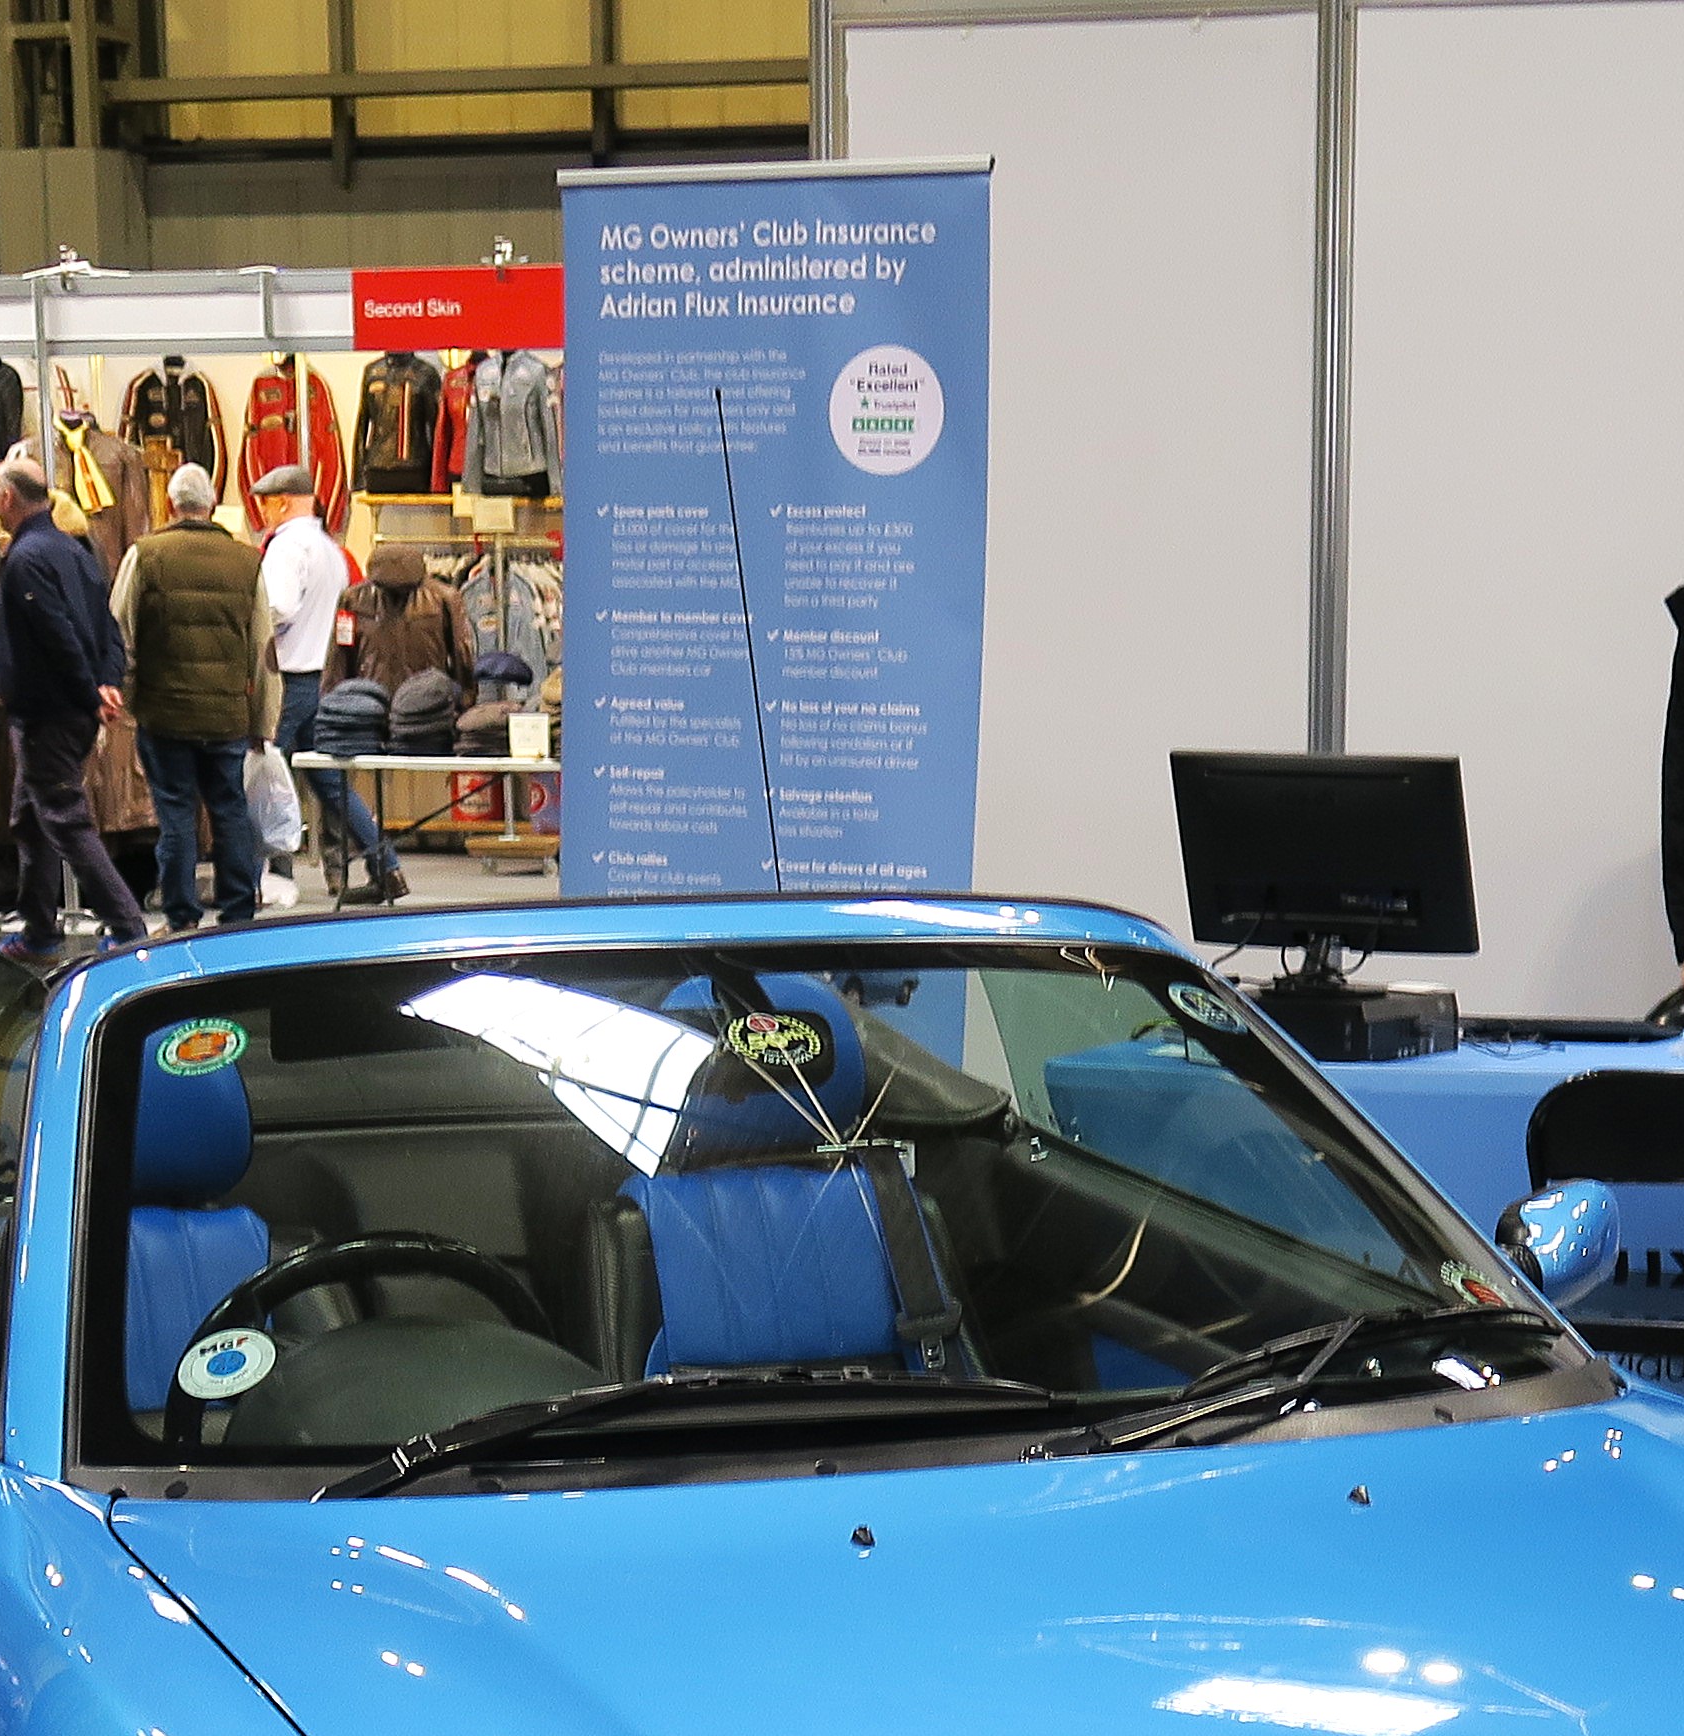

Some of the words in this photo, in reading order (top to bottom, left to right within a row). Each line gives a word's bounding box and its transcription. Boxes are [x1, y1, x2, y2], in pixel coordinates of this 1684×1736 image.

[601, 224, 642, 251] MG
[651, 222, 744, 249] Owners'
[753, 220, 807, 247] Club
[601, 258, 702, 286] scheme,
[710, 253, 867, 282] administered
[876, 252, 905, 285] by
[364, 299, 423, 318] Second
[426, 297, 463, 318] Skin
[601, 292, 676, 319] Adrian
[685, 291, 729, 317] Flux
[738, 291, 855, 316] Insurance
[869, 362, 908, 377] Rated
